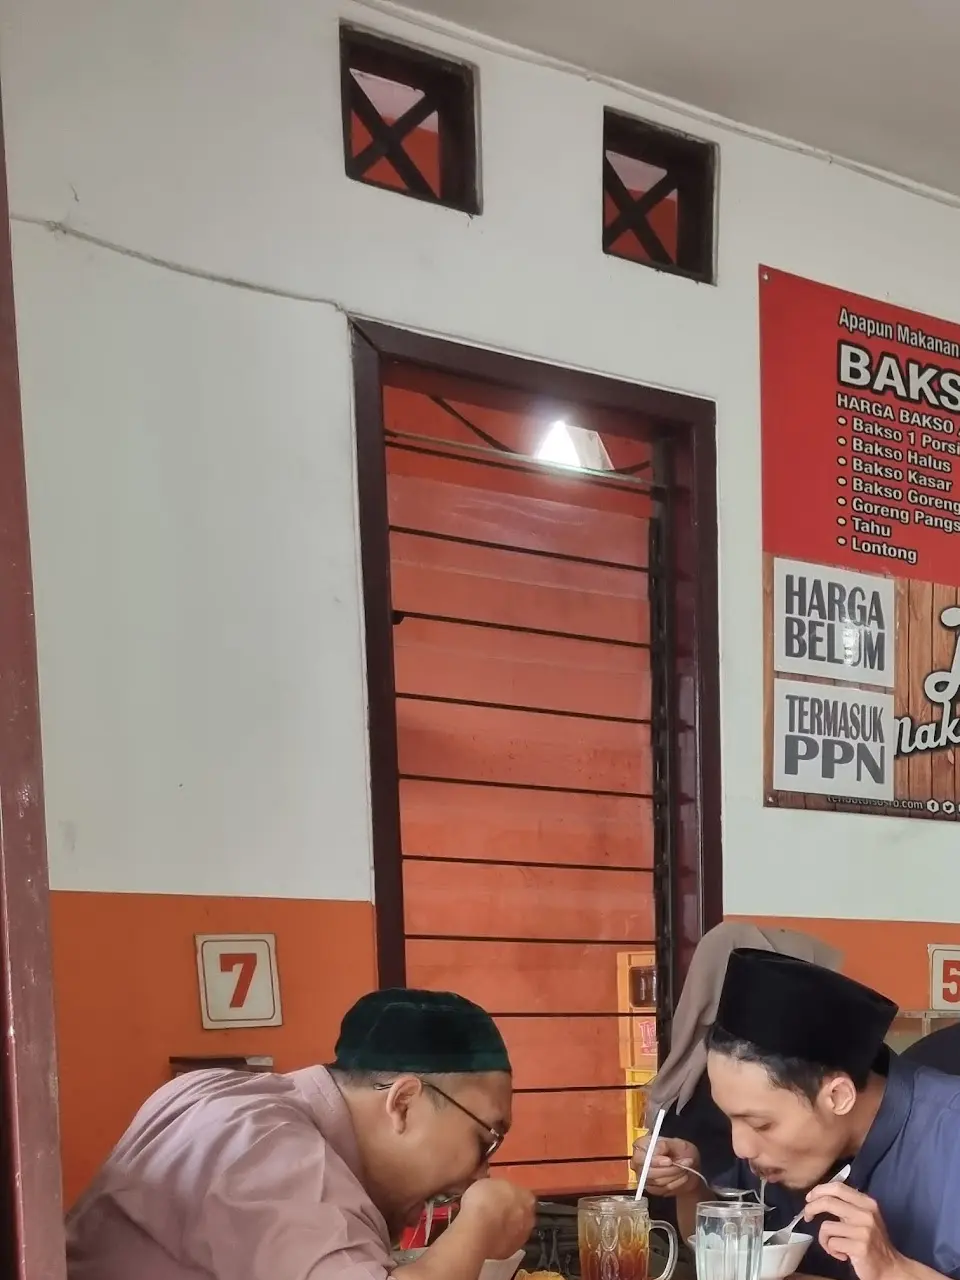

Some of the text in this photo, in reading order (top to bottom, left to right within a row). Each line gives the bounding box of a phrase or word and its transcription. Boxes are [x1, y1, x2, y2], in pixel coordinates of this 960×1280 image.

[838, 307, 893, 337] Apapun
[837, 393, 895, 421] HARGA
[899, 409, 955, 434] BAKSO
[852, 417, 903, 443] Bakso
[907, 431, 916, 446] 1
[852, 437, 952, 473] Bakso Halus
[852, 457, 953, 492] Bakso Kasar
[852, 477, 903, 501] Bakso
[852, 497, 910, 524] Goreng
[852, 516, 891, 537] Tahu
[851, 536, 918, 564] Lontong
[784, 573, 886, 631] HARGA
[784, 616, 886, 672] BELUM
[784, 694, 885, 744] TERMASUK
[783, 734, 886, 785] PPN
[219, 952, 258, 1009] 7
